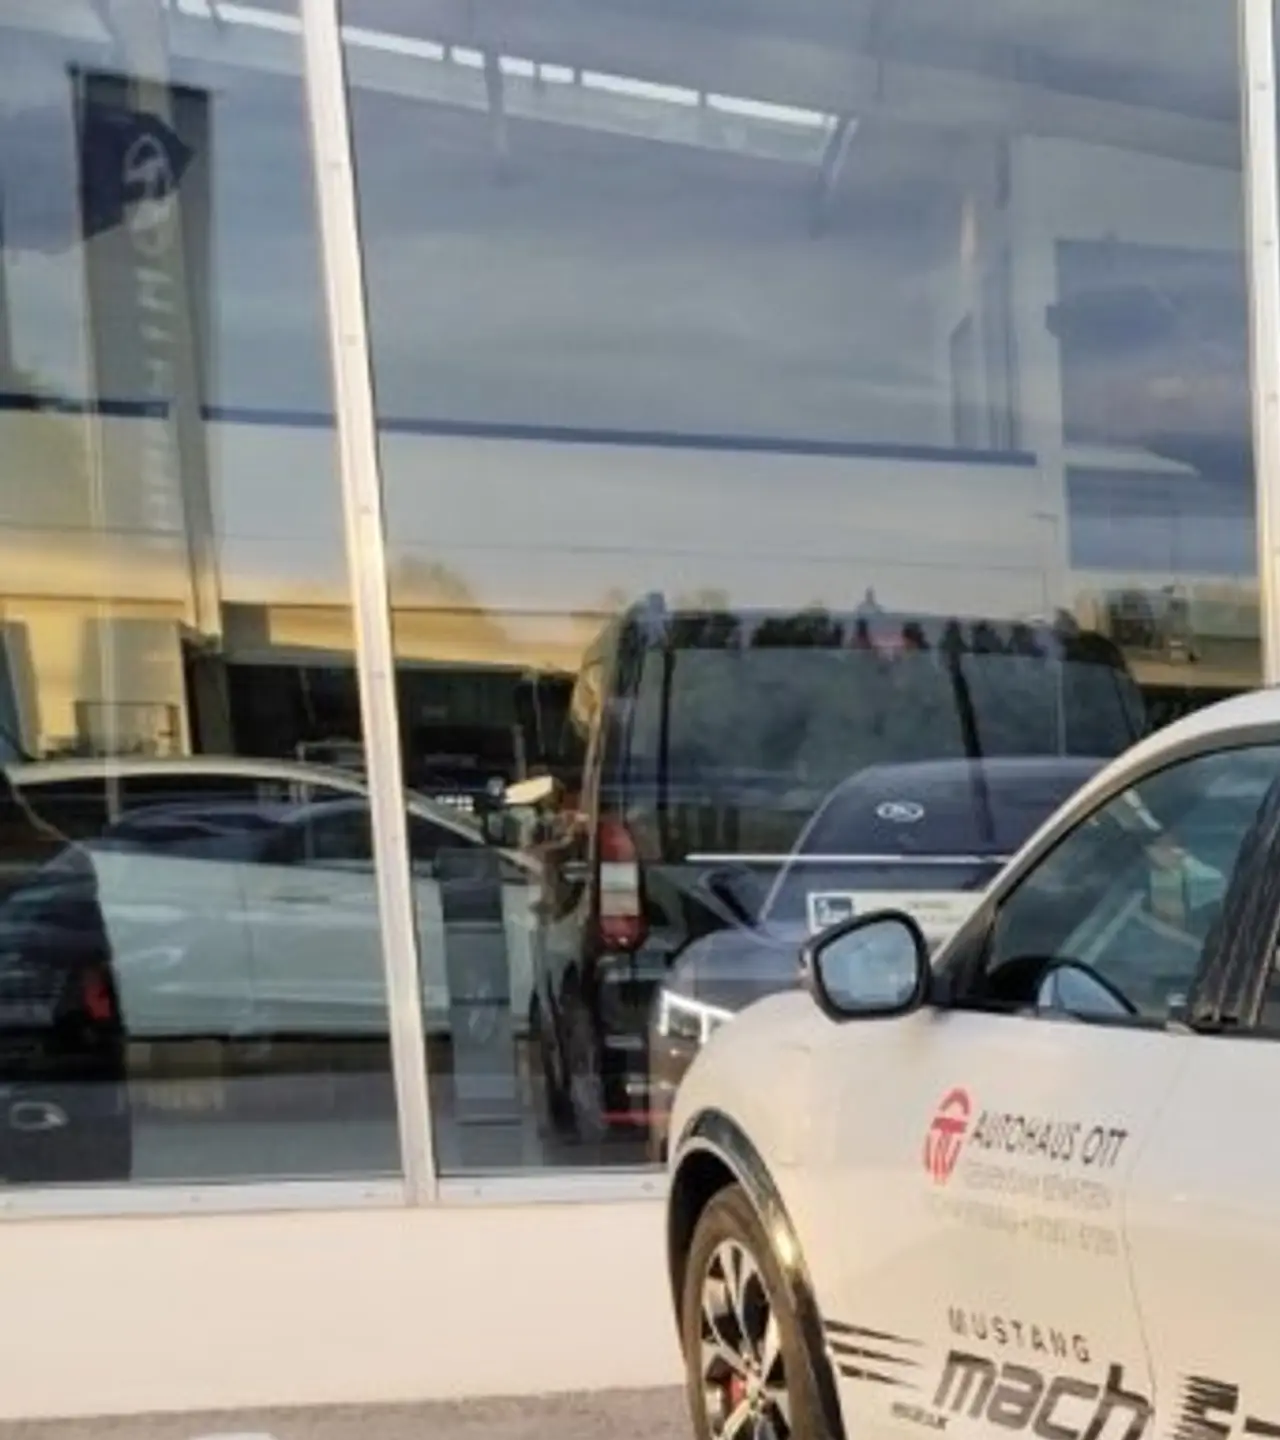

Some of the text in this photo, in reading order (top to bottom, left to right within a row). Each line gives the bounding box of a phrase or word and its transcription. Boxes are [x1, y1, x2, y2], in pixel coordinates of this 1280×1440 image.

[970, 1110, 1130, 1168] AUTOHAUS OTT
[947, 1305, 1092, 1364] MUSTANG
